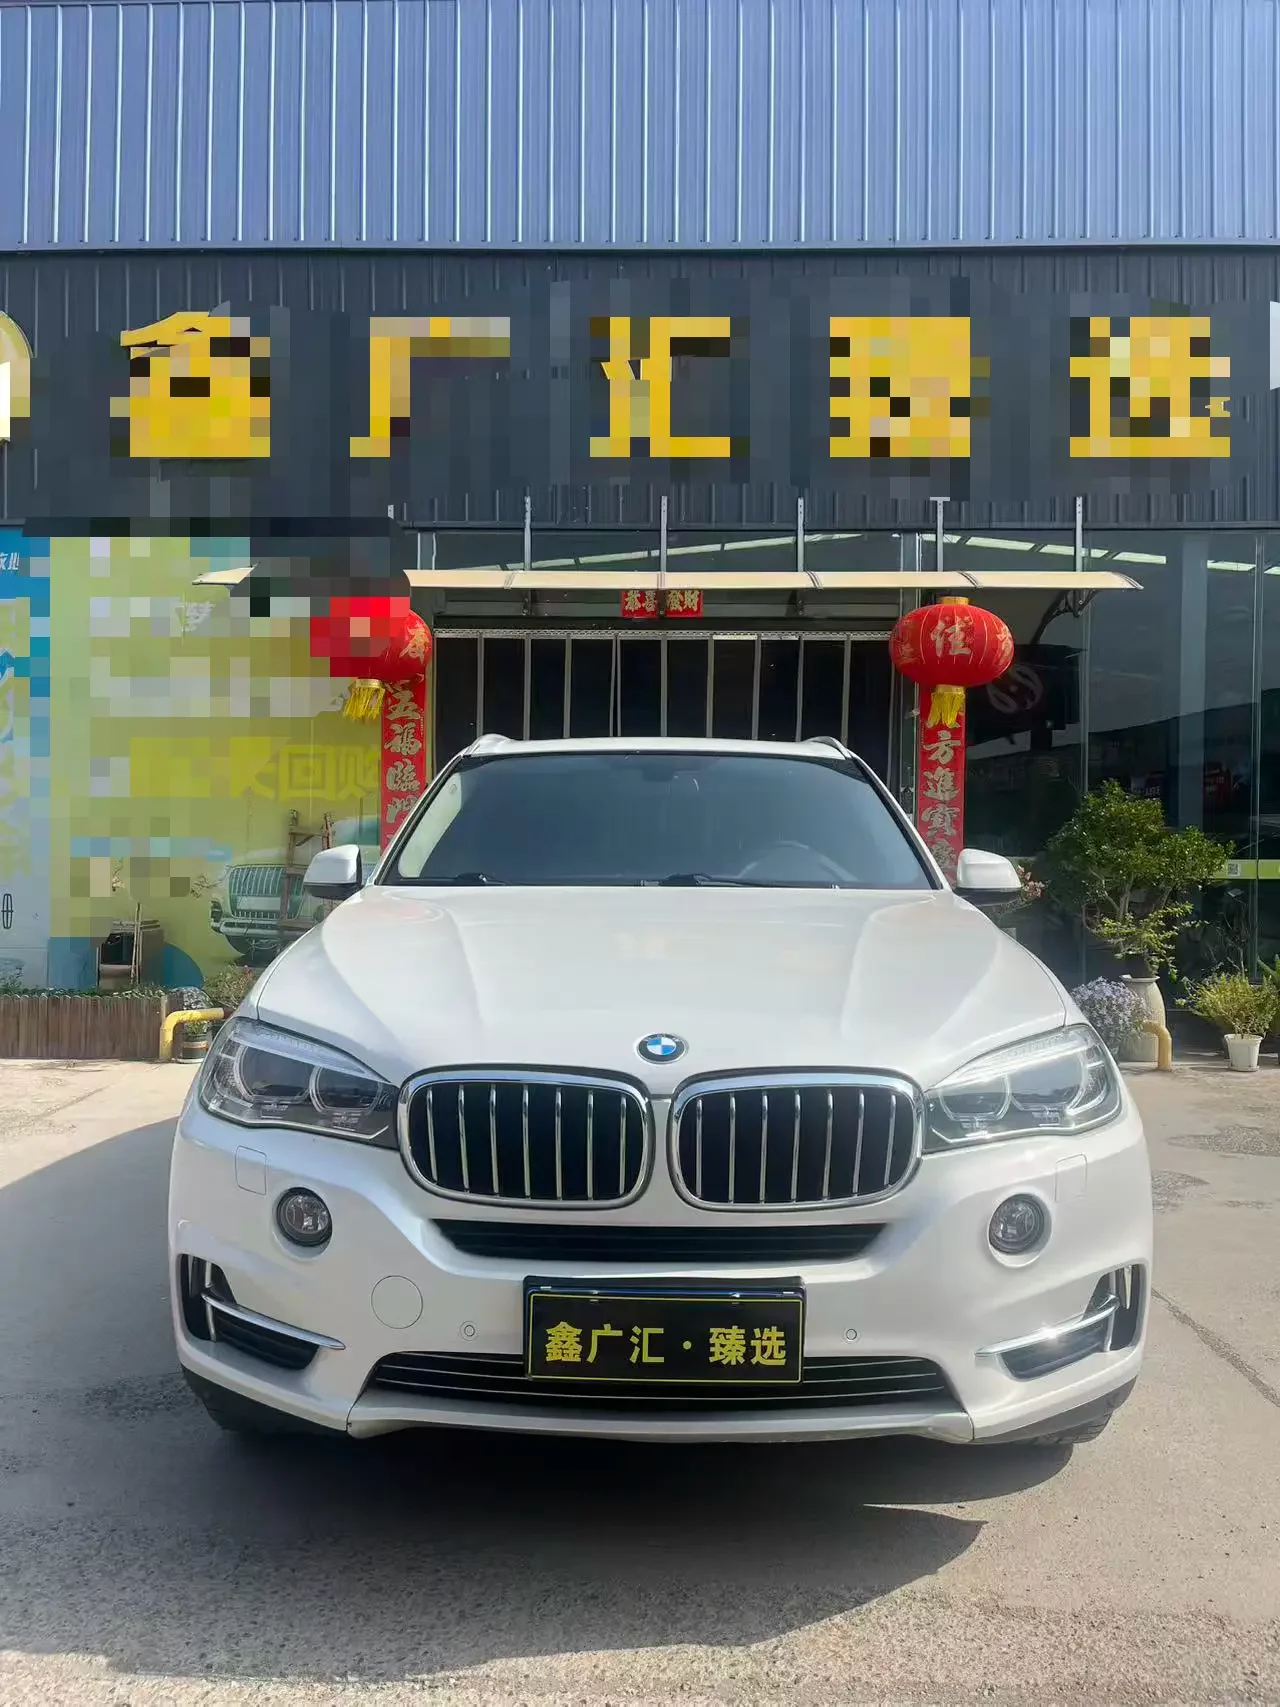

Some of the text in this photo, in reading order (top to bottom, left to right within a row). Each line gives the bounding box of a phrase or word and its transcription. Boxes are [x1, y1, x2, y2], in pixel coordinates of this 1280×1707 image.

[545, 1321, 786, 1367] 鑫广汇·臻选
